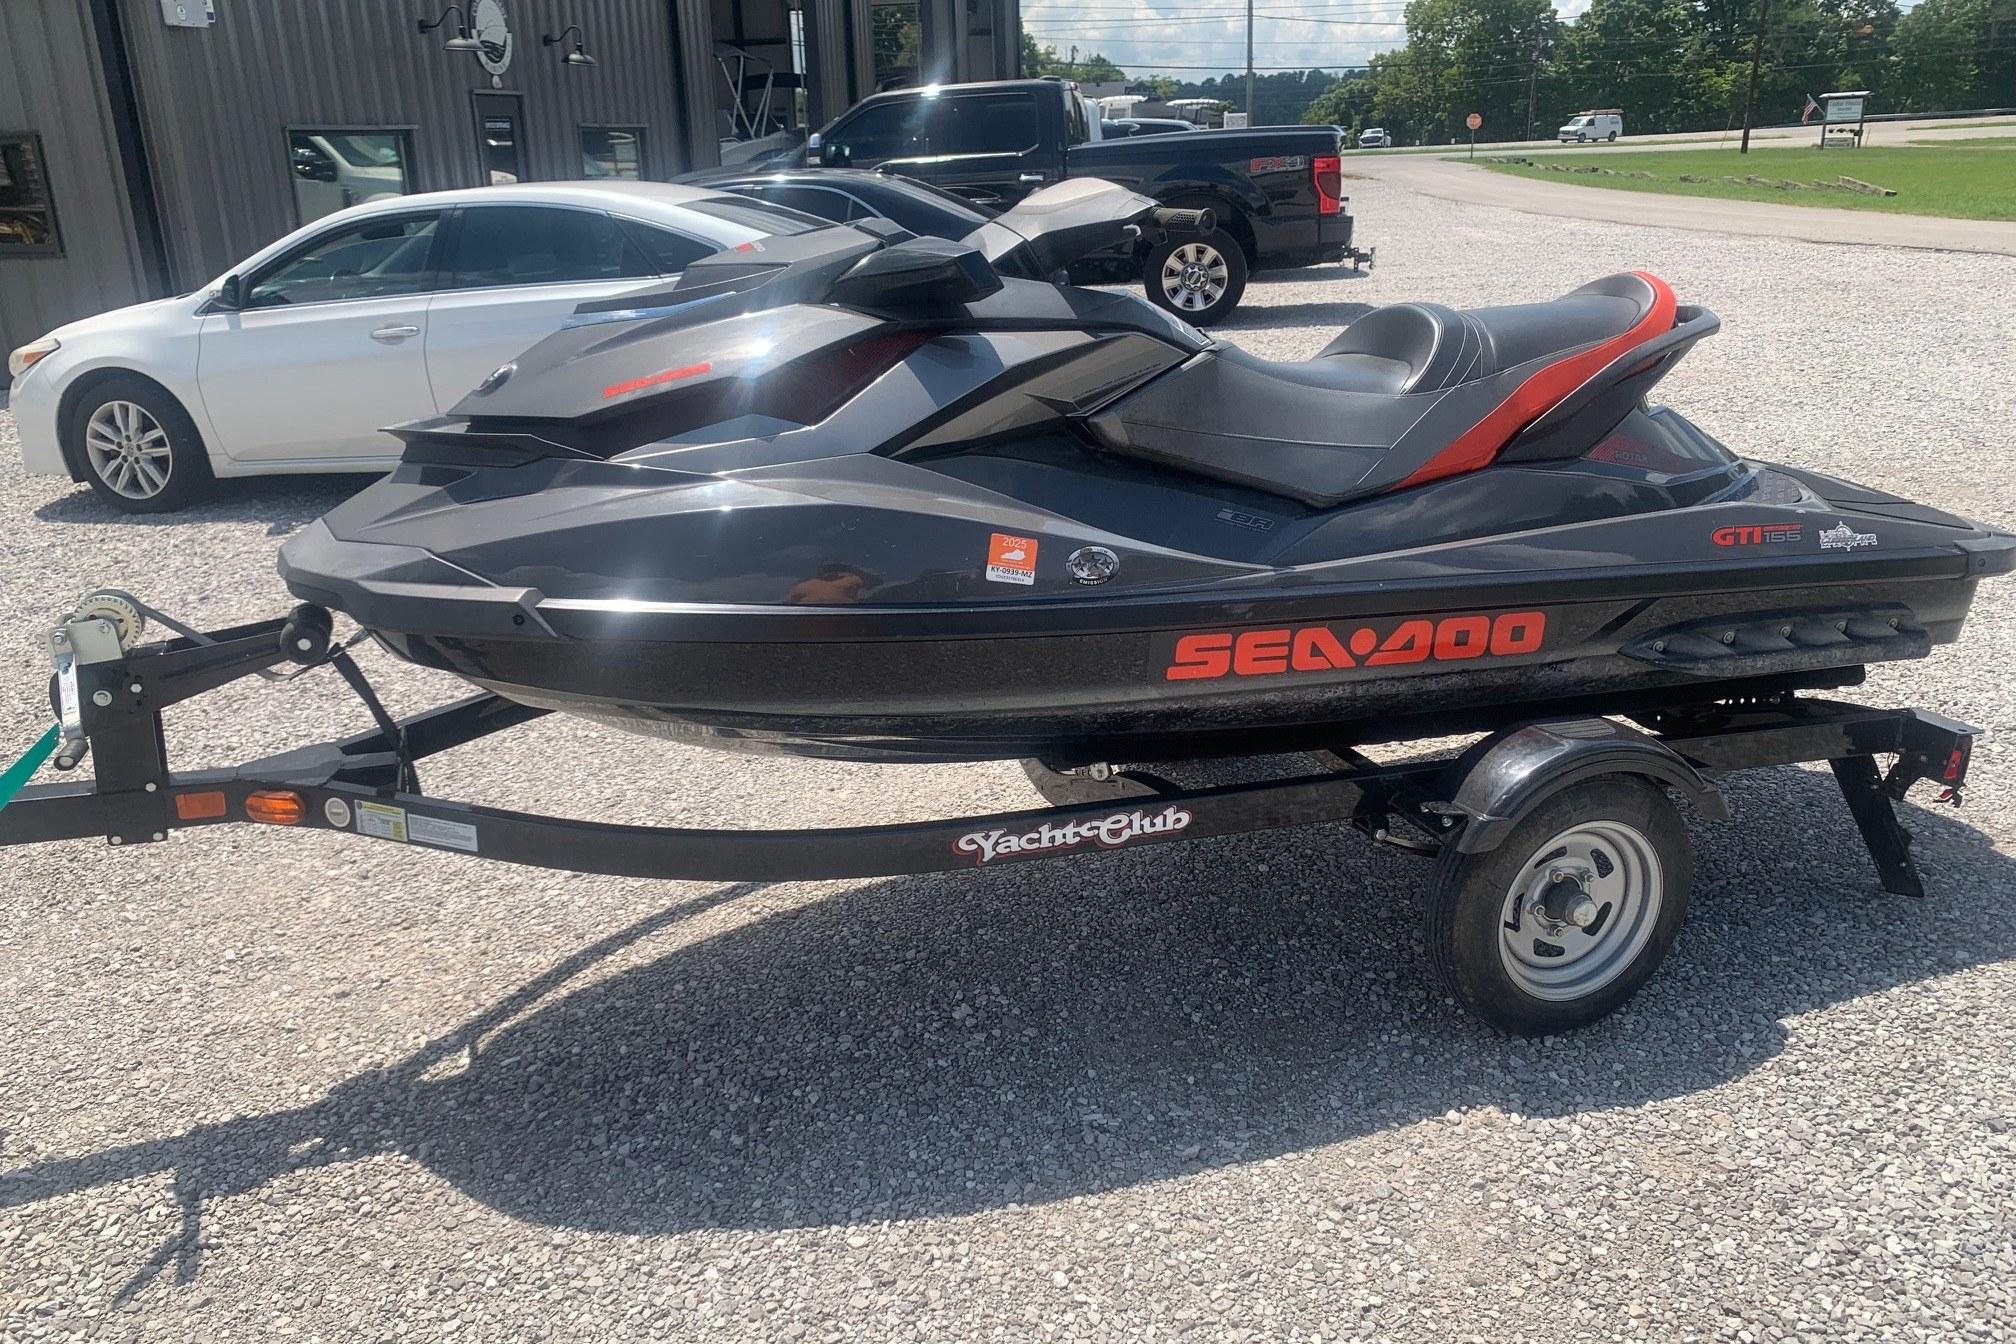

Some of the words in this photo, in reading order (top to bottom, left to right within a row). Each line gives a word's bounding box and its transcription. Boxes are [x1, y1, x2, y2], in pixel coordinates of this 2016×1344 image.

[1002, 536, 1028, 549] 2025
[1712, 527, 1762, 546] GTI
[990, 565, 1034, 578] KY-0939-MZ
